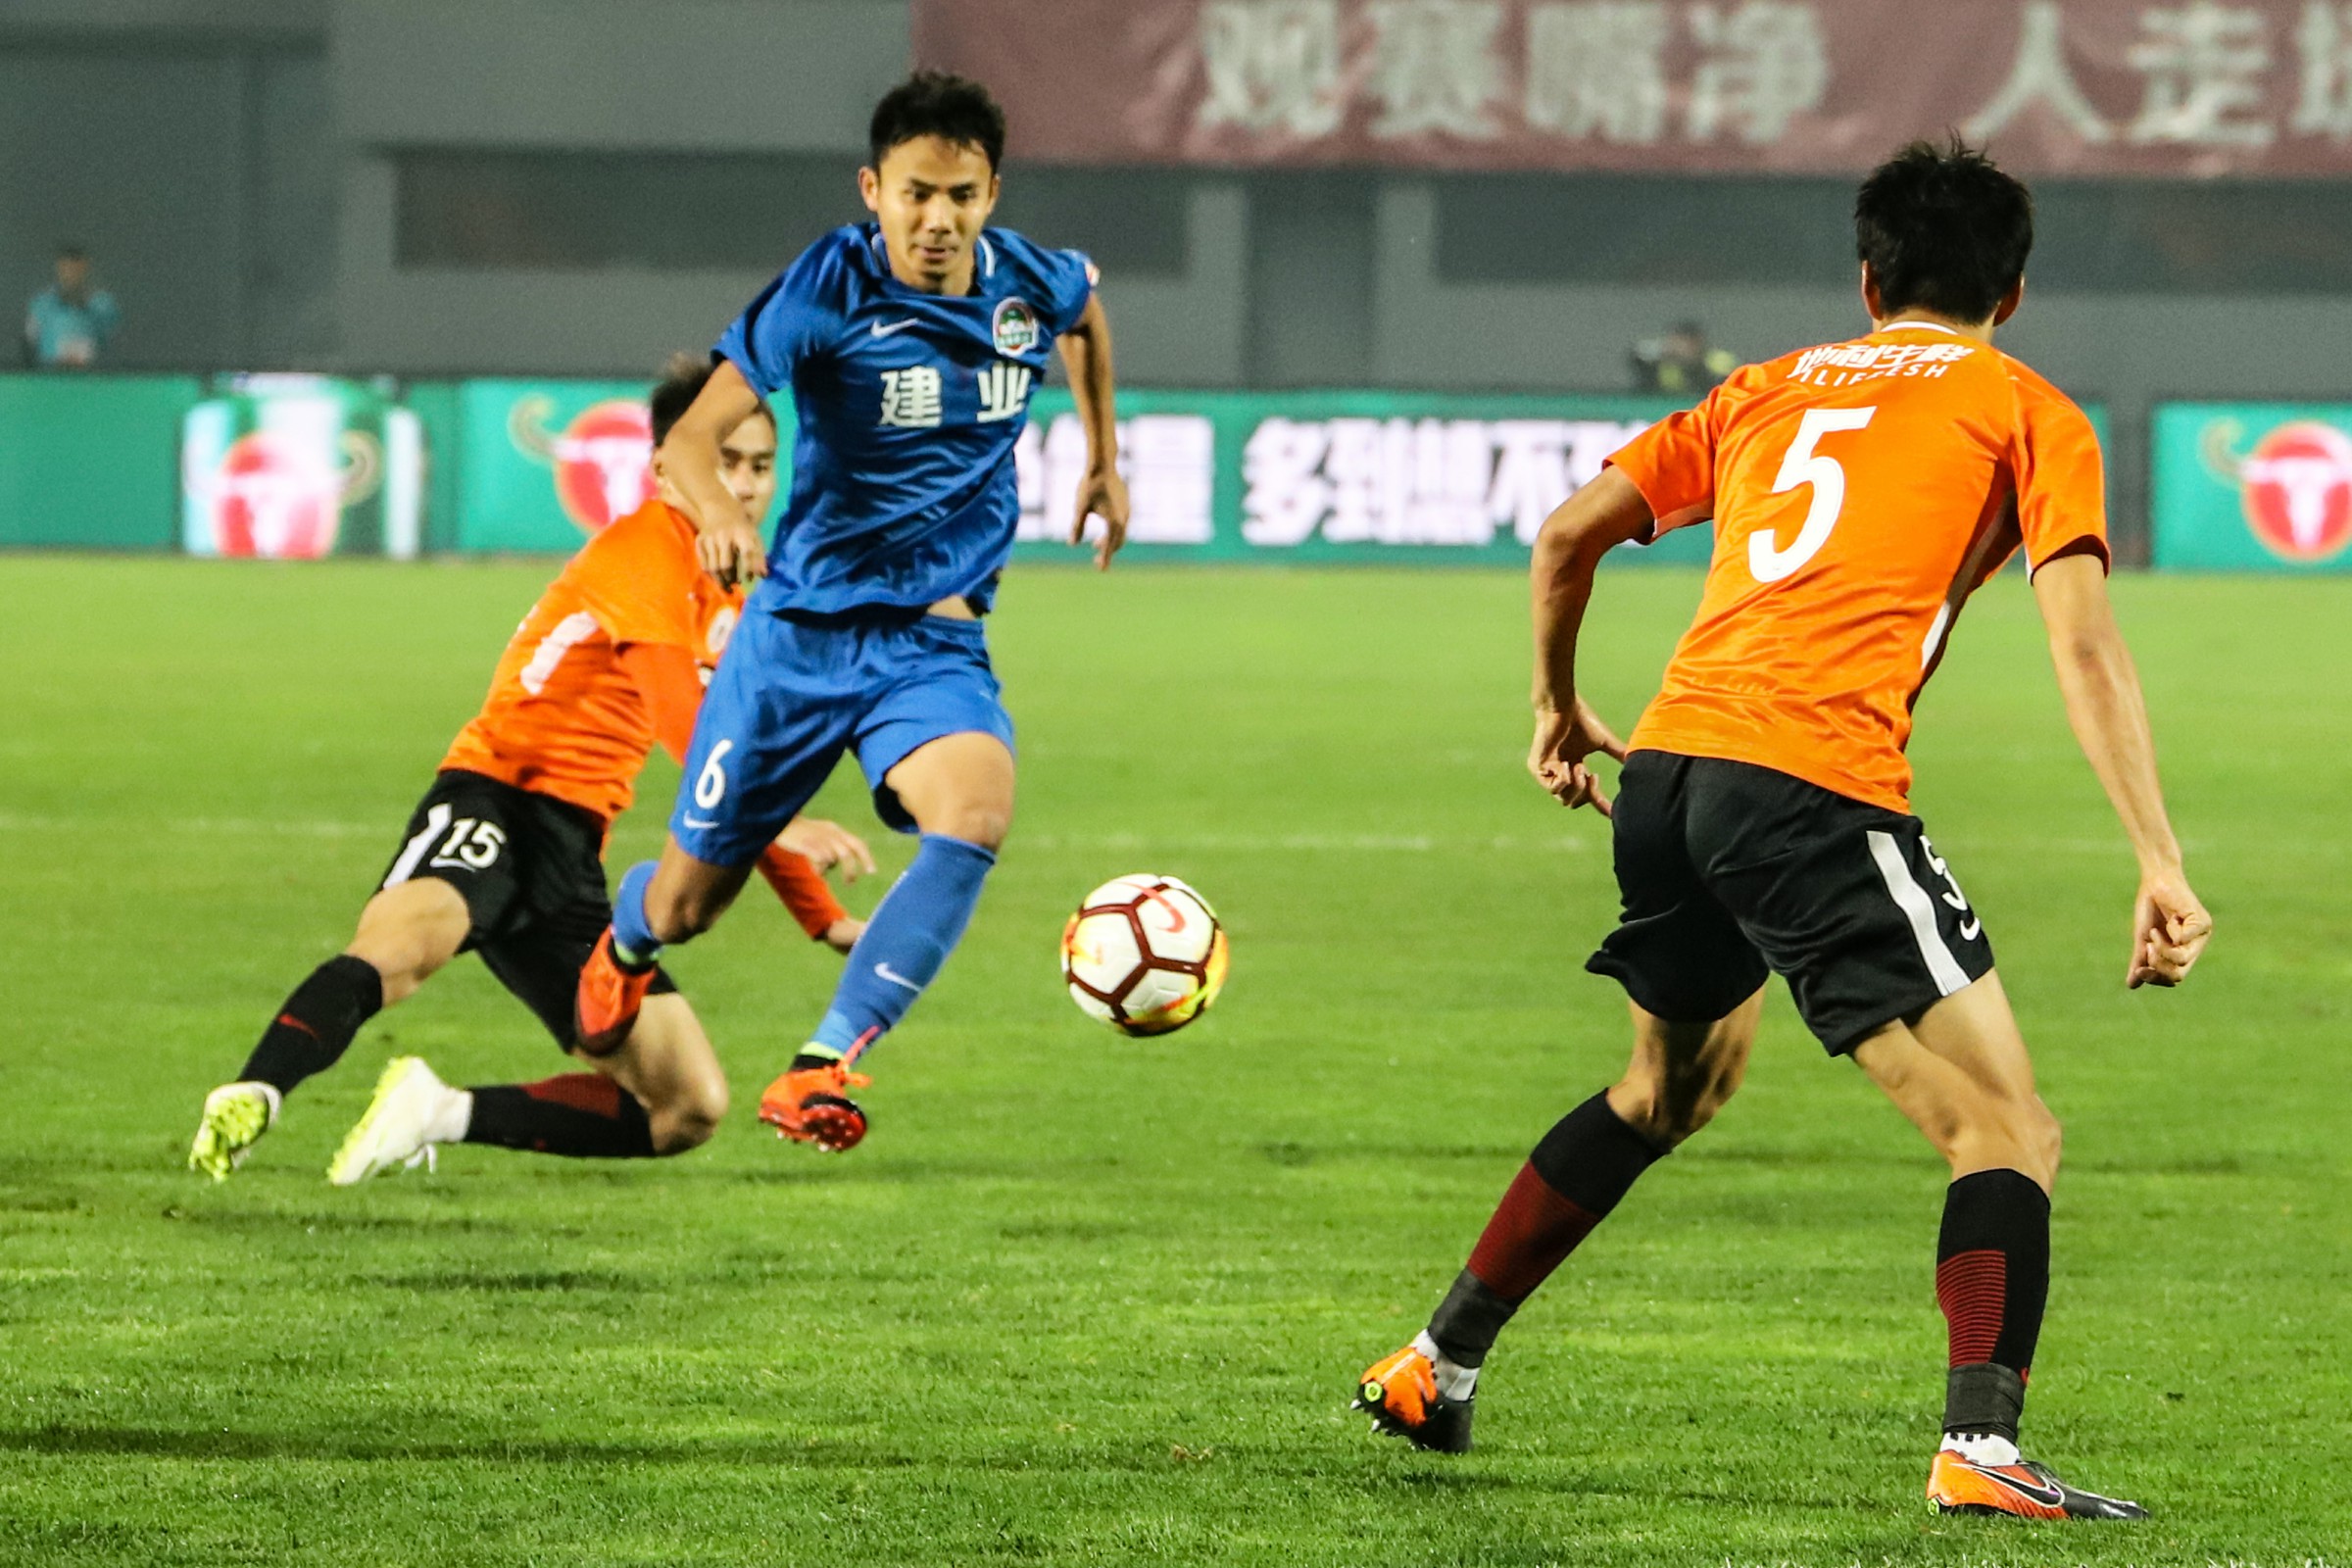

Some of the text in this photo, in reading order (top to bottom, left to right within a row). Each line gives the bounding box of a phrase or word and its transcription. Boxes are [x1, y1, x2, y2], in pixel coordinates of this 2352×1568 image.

[1748, 405, 1878, 584] 5
[695, 738, 733, 809] 6
[439, 816, 508, 869] 15
